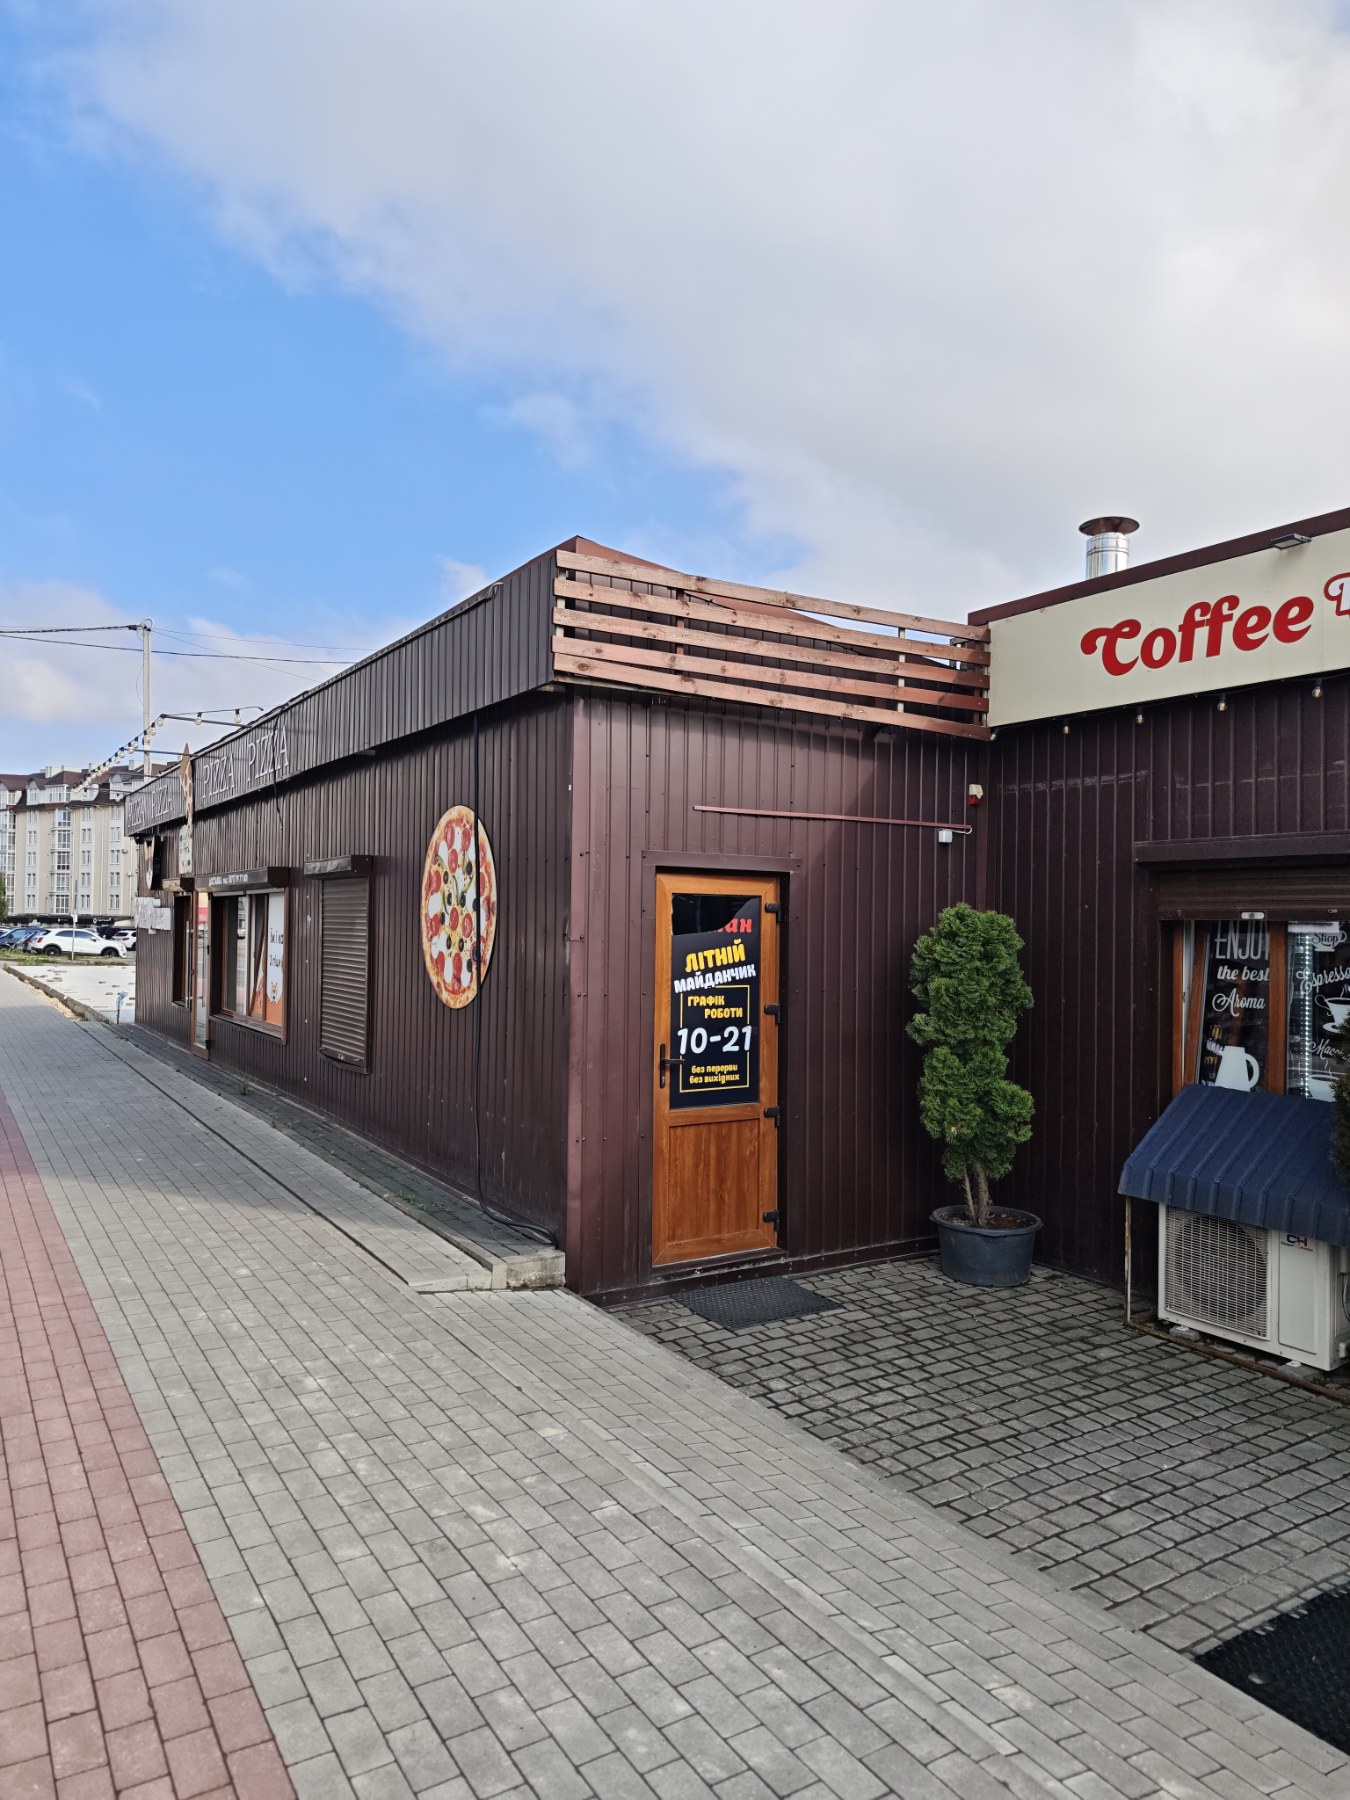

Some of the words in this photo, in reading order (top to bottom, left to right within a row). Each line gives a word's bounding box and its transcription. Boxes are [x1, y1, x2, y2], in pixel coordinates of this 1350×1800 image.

[1080, 595, 1314, 676] Coffee
[202, 753, 235, 799] PIZZA
[247, 725, 289, 784] PIZZA
[718, 918, 752, 933] ан
[685, 938, 746, 973] ЛІТНІЙ
[674, 964, 756, 993] МАЙДАНЧИК
[1216, 965, 1239, 980] the
[1241, 966, 1270, 981] best
[687, 995, 725, 1007] ГРАФІК
[1212, 987, 1266, 1017] Aroma
[704, 1007, 743, 1019] РОБОТИ
[677, 1025, 752, 1055] 10-21
[691, 1065, 705, 1074] без
[706, 1064, 738, 1075] перерви
[689, 1075, 703, 1084] без
[704, 1073, 740, 1084] вихідних
[1286, 1233, 1308, 1247] CH
